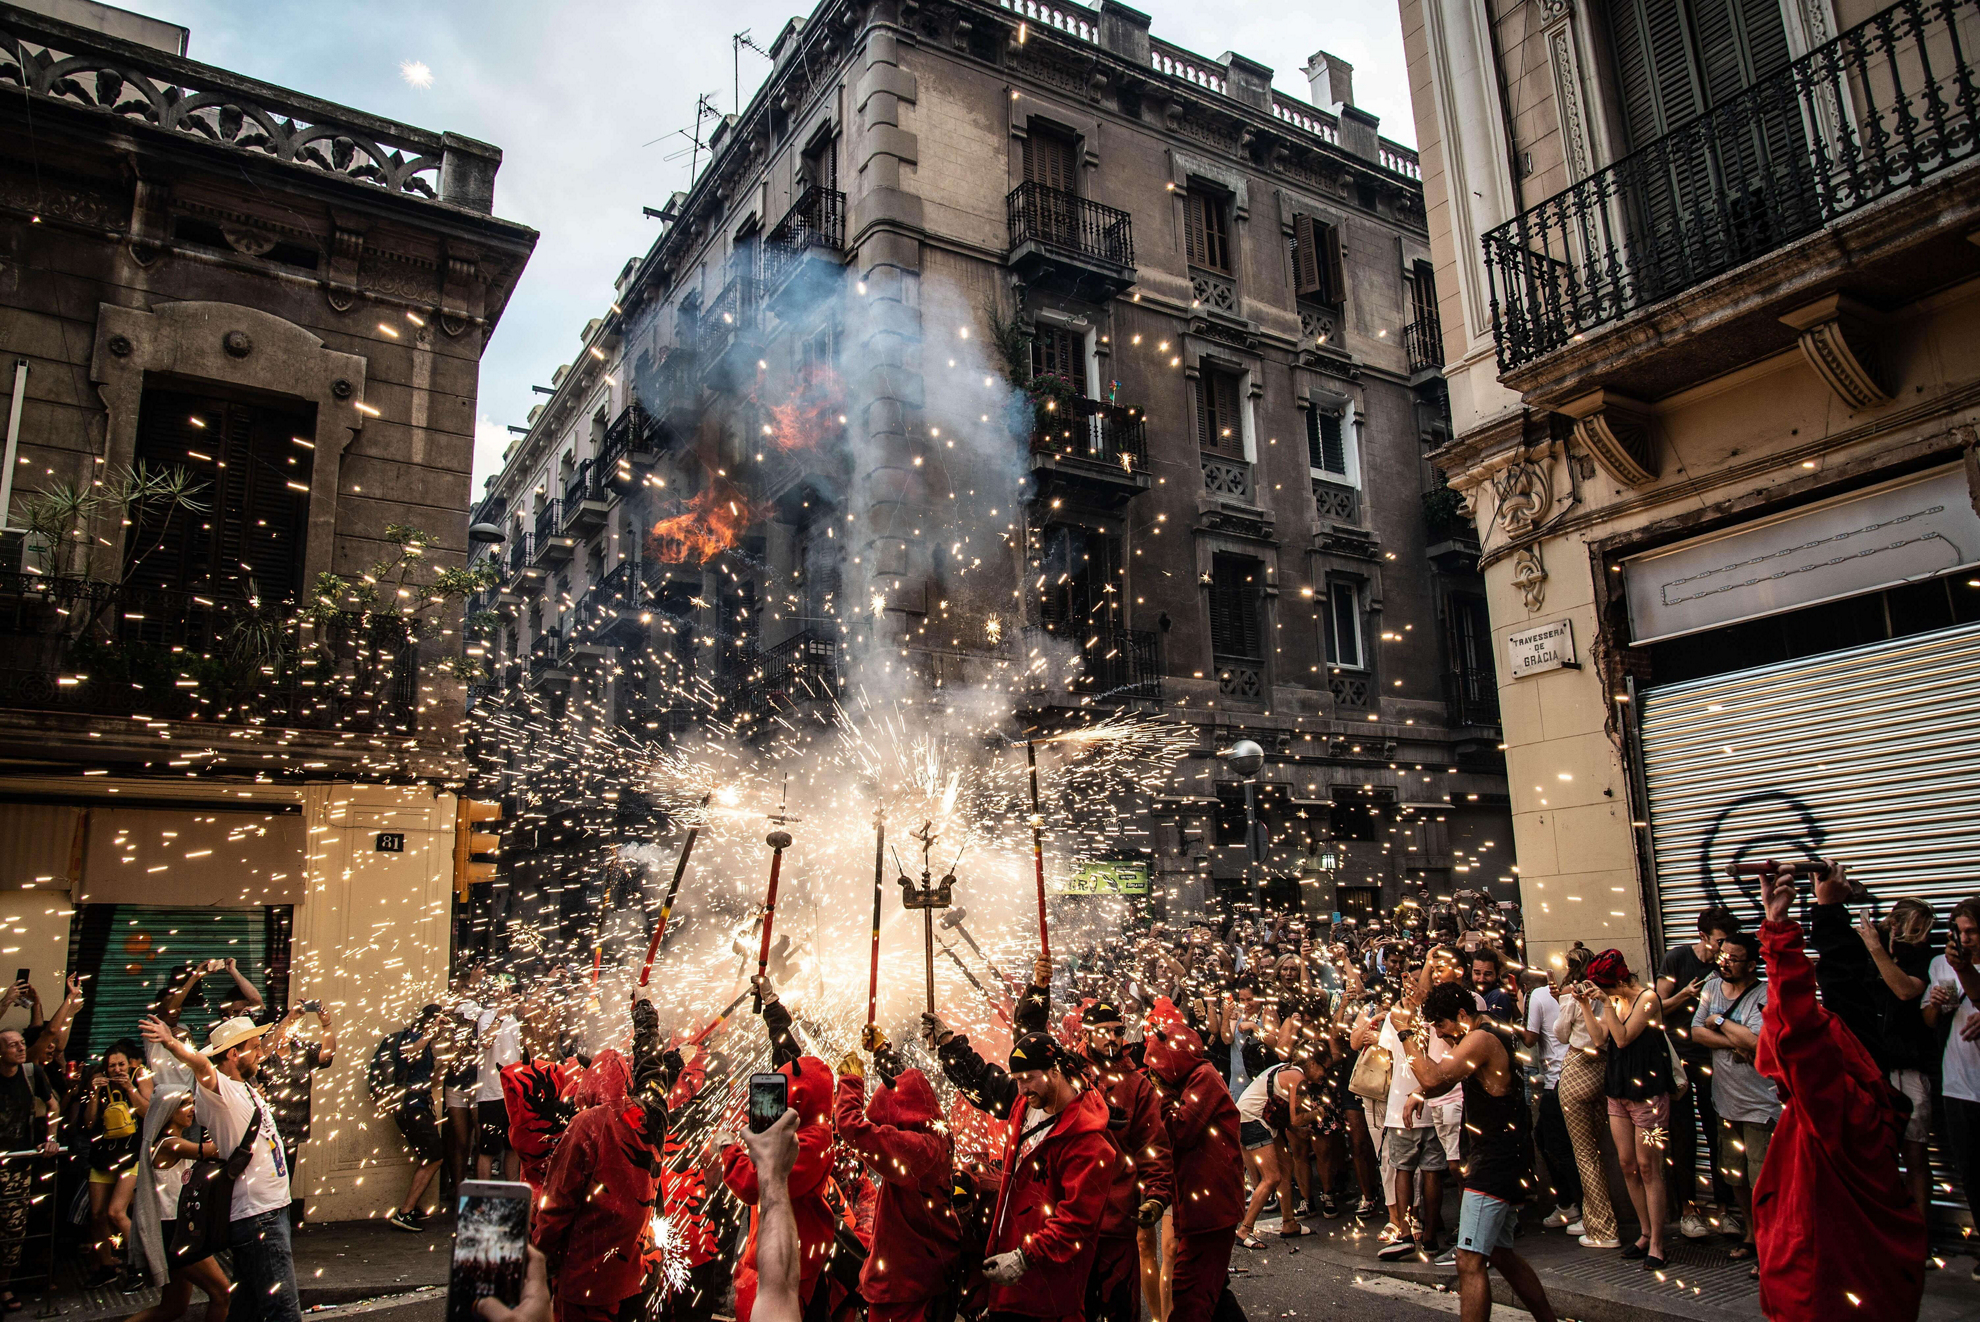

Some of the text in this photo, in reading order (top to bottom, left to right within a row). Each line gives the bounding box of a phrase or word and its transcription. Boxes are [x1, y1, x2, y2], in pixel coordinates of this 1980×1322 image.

[1513, 628, 1565, 647] TRAVESSERA
[1534, 643, 1545, 652] DE
[1524, 650, 1559, 667] GRÀCIA
[382, 835, 399, 850] 81
